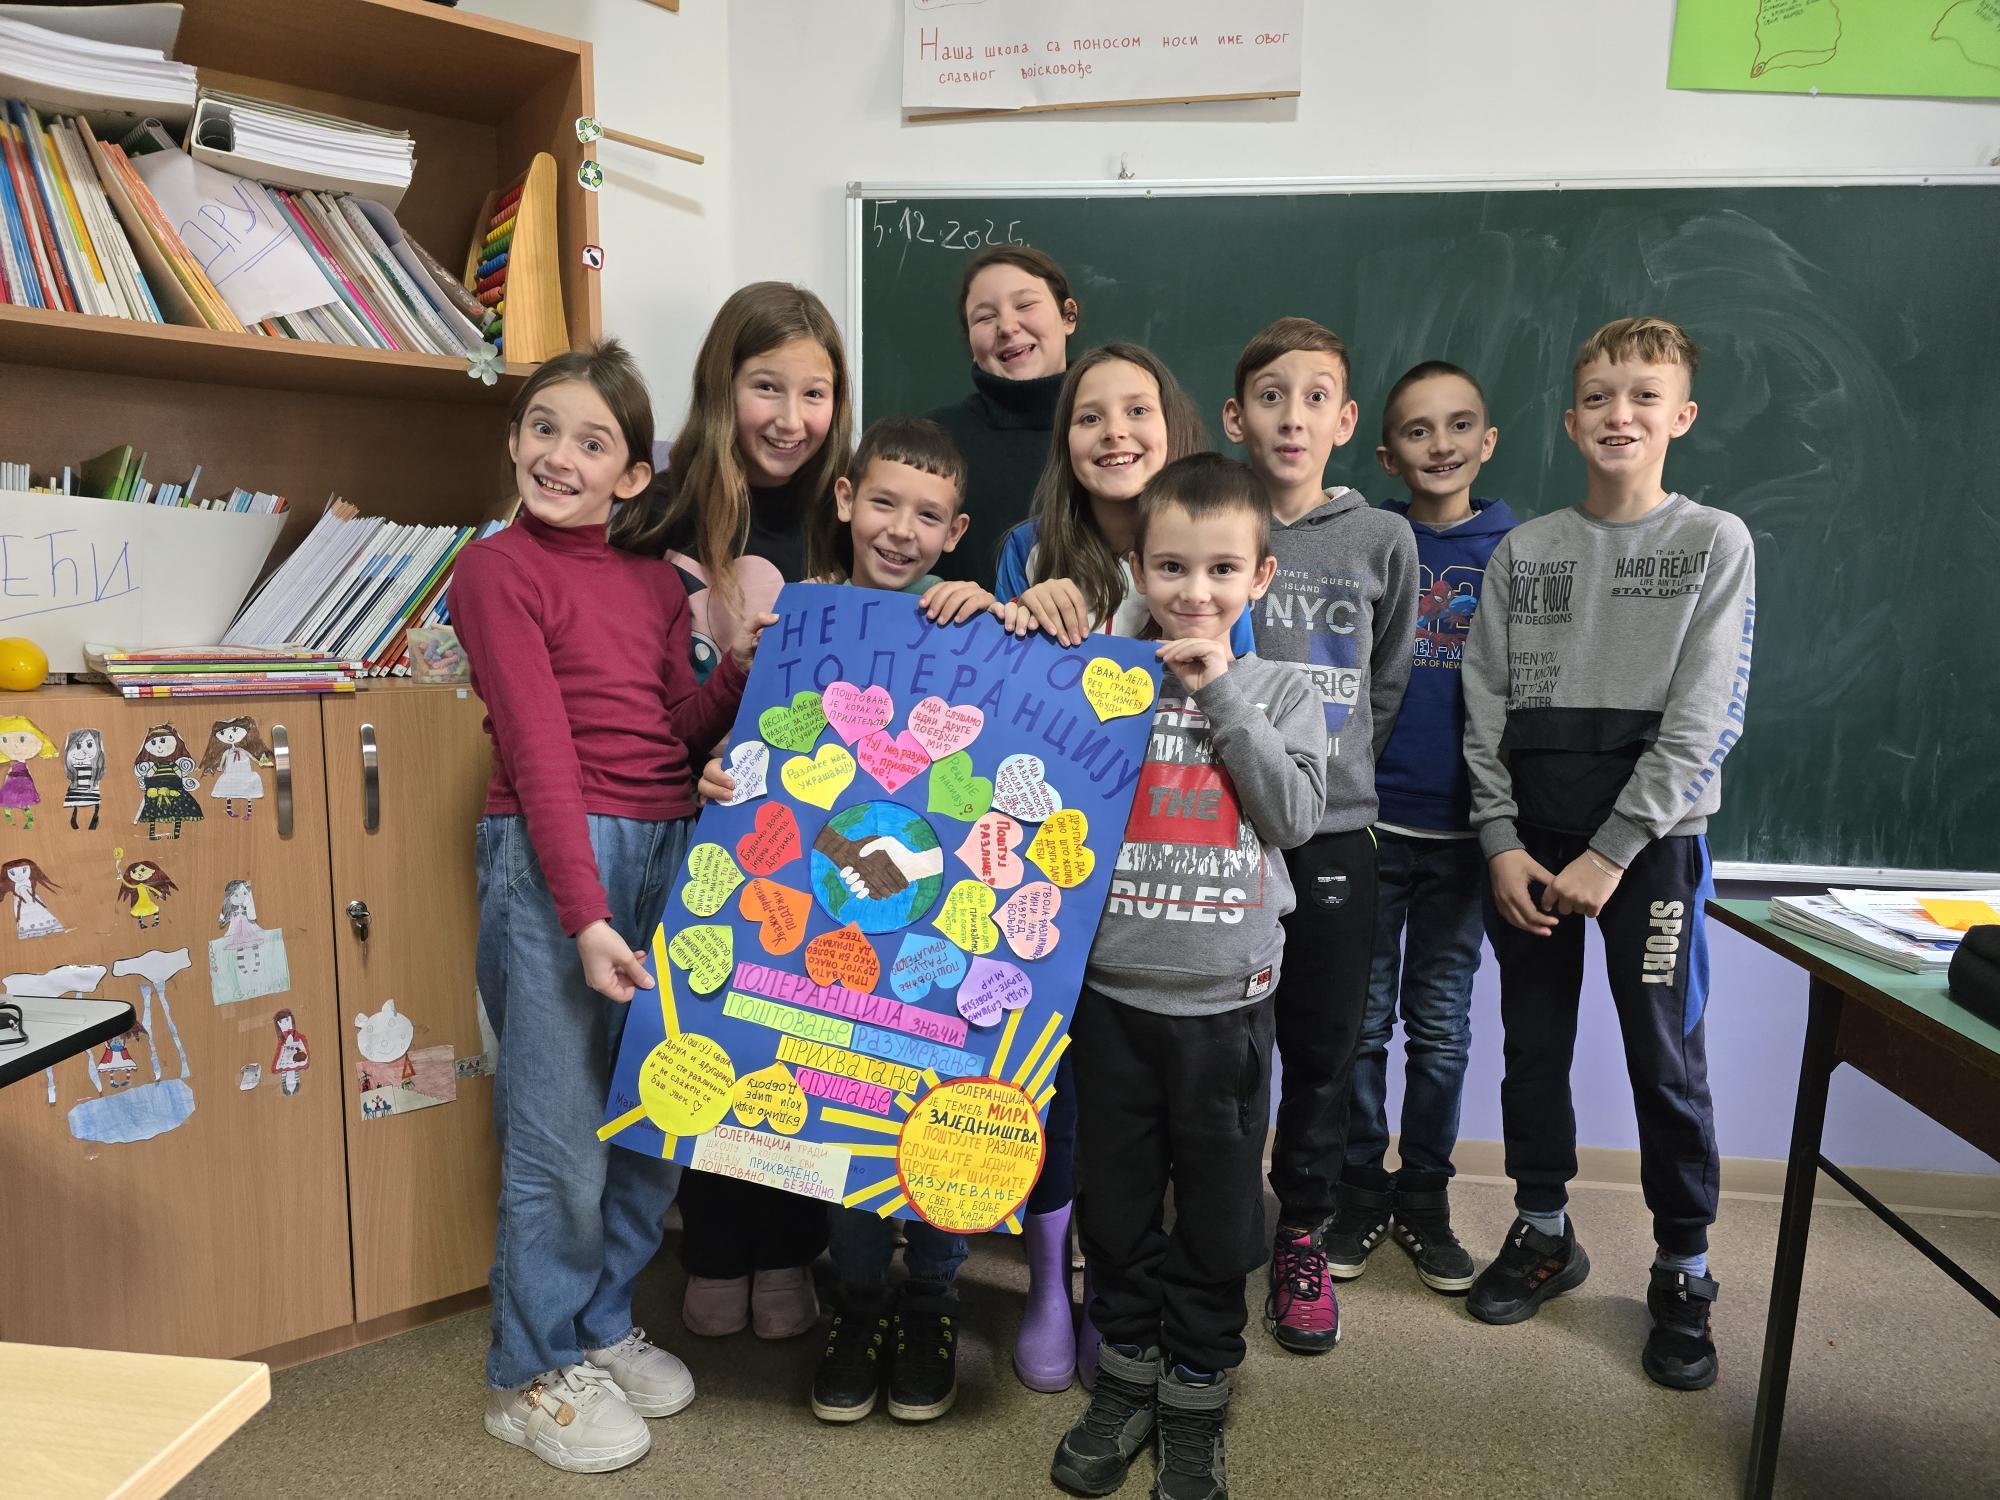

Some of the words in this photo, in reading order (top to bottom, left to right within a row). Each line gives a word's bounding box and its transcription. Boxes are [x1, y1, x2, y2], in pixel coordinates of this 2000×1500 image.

[919, 26, 974, 61] Наша
[985, 43, 1029, 58] школа
[1046, 42, 1060, 52] са
[1073, 36, 1142, 50] поносом
[1164, 35, 1199, 48] носи
[1219, 34, 1248, 45] име
[1255, 33, 1290, 45] овог
[940, 69, 996, 84] славног
[1021, 62, 1093, 81] војсковође
[1276, 569, 1310, 579] STATE
[1511, 560, 1536, 579] YOU
[1538, 561, 1578, 580] MUST
[1615, 557, 1656, 579] HARD
[1659, 550, 1709, 578] REALIT
[1611, 587, 1652, 596] STAY
[1640, 578, 1654, 586] LIFE
[1542, 575, 1574, 613] YOUR
[1265, 593, 1357, 634] NYC
[1525, 614, 1573, 625] DECISIONS
[1429, 659, 1440, 668] OF
[1541, 651, 1558, 665] YOU
[1091, 665, 1121, 681] СВАКА
[1125, 674, 1148, 687] ЛЕПА
[1534, 666, 1561, 681] KNOW
[832, 688, 889, 706] ПОШТОВАЊЕ
[1087, 677, 1103, 690] РЕЧ
[1110, 683, 1138, 697] ГРАДИ
[1088, 689, 1110, 699] МОСТ
[1536, 681, 1558, 696] SAY
[845, 703, 870, 714] КОРАК
[921, 700, 941, 715] КАДА
[945, 710, 982, 728] СЛУШАМО
[778, 650, 1141, 799] ТОЛЕРАНЦИЈУ
[913, 712, 938, 726] ЈЕДНИ
[943, 721, 972, 735] ДРУГЕ
[914, 724, 960, 743] ПОБЕЂУЈЕ
[926, 739, 951, 753] МИР
[1006, 764, 1023, 792] ШКОЛА
[1148, 785, 1223, 821] THE
[1066, 814, 1083, 858] ДРУГИМА
[1109, 879, 1248, 924] RULES
[1015, 895, 1028, 934] РАЗРЕД
[838, 931, 862, 943] ТЕБЕ
[1642, 900, 1684, 987] SPORT
[807, 946, 835, 959] ВОЛЕО
[808, 957, 838, 969] ОНАКО
[853, 954, 877, 966] КАКО
[911, 952, 948, 974] ГРАДИ
[671, 940, 713, 991] ТОЛЕРАНЦИЈА
[811, 967, 868, 986] ПРИХВАТИ
[841, 963, 878, 976] ДРУГОГ
[899, 962, 960, 992] ПОШТОВАЊЕ
[981, 969, 1005, 990] МИР
[736, 962, 903, 1027] ТОЛЕРАНЦИЈА
[1005, 985, 1029, 1003] КАДА
[951, 1084, 1025, 1106] ТОЛЕРАНЦИЈА
[927, 1097, 939, 1107] ЈЕ
[945, 1100, 982, 1116] ТЕМЕЉ
[987, 1103, 1028, 1124] МИРА
[714, 1126, 791, 1152] ТОЛЕРАНЦИЈА
[922, 1126, 981, 1149] ПОШТУЈТЕ
[903, 1142, 972, 1168] СЛУШАЈТЕ
[980, 1157, 1015, 1173] ЈЕДНИ
[698, 1159, 765, 1182] ПОШТОВАНО
[750, 1157, 824, 1184] ПРИХВАЋЕНО,
[901, 1159, 940, 1177] ДРУГЕ
[967, 1170, 1027, 1190] ШИРИТЕ
[910, 1191, 925, 1202] ЈЕР
[929, 1194, 951, 1207] СВЕТ
[956, 1200, 967, 1210] ЈЕ
[971, 1200, 1000, 1213] БОЉЕ
[925, 1204, 954, 1218] МЕСТО
[960, 1209, 983, 1221] КАДА
